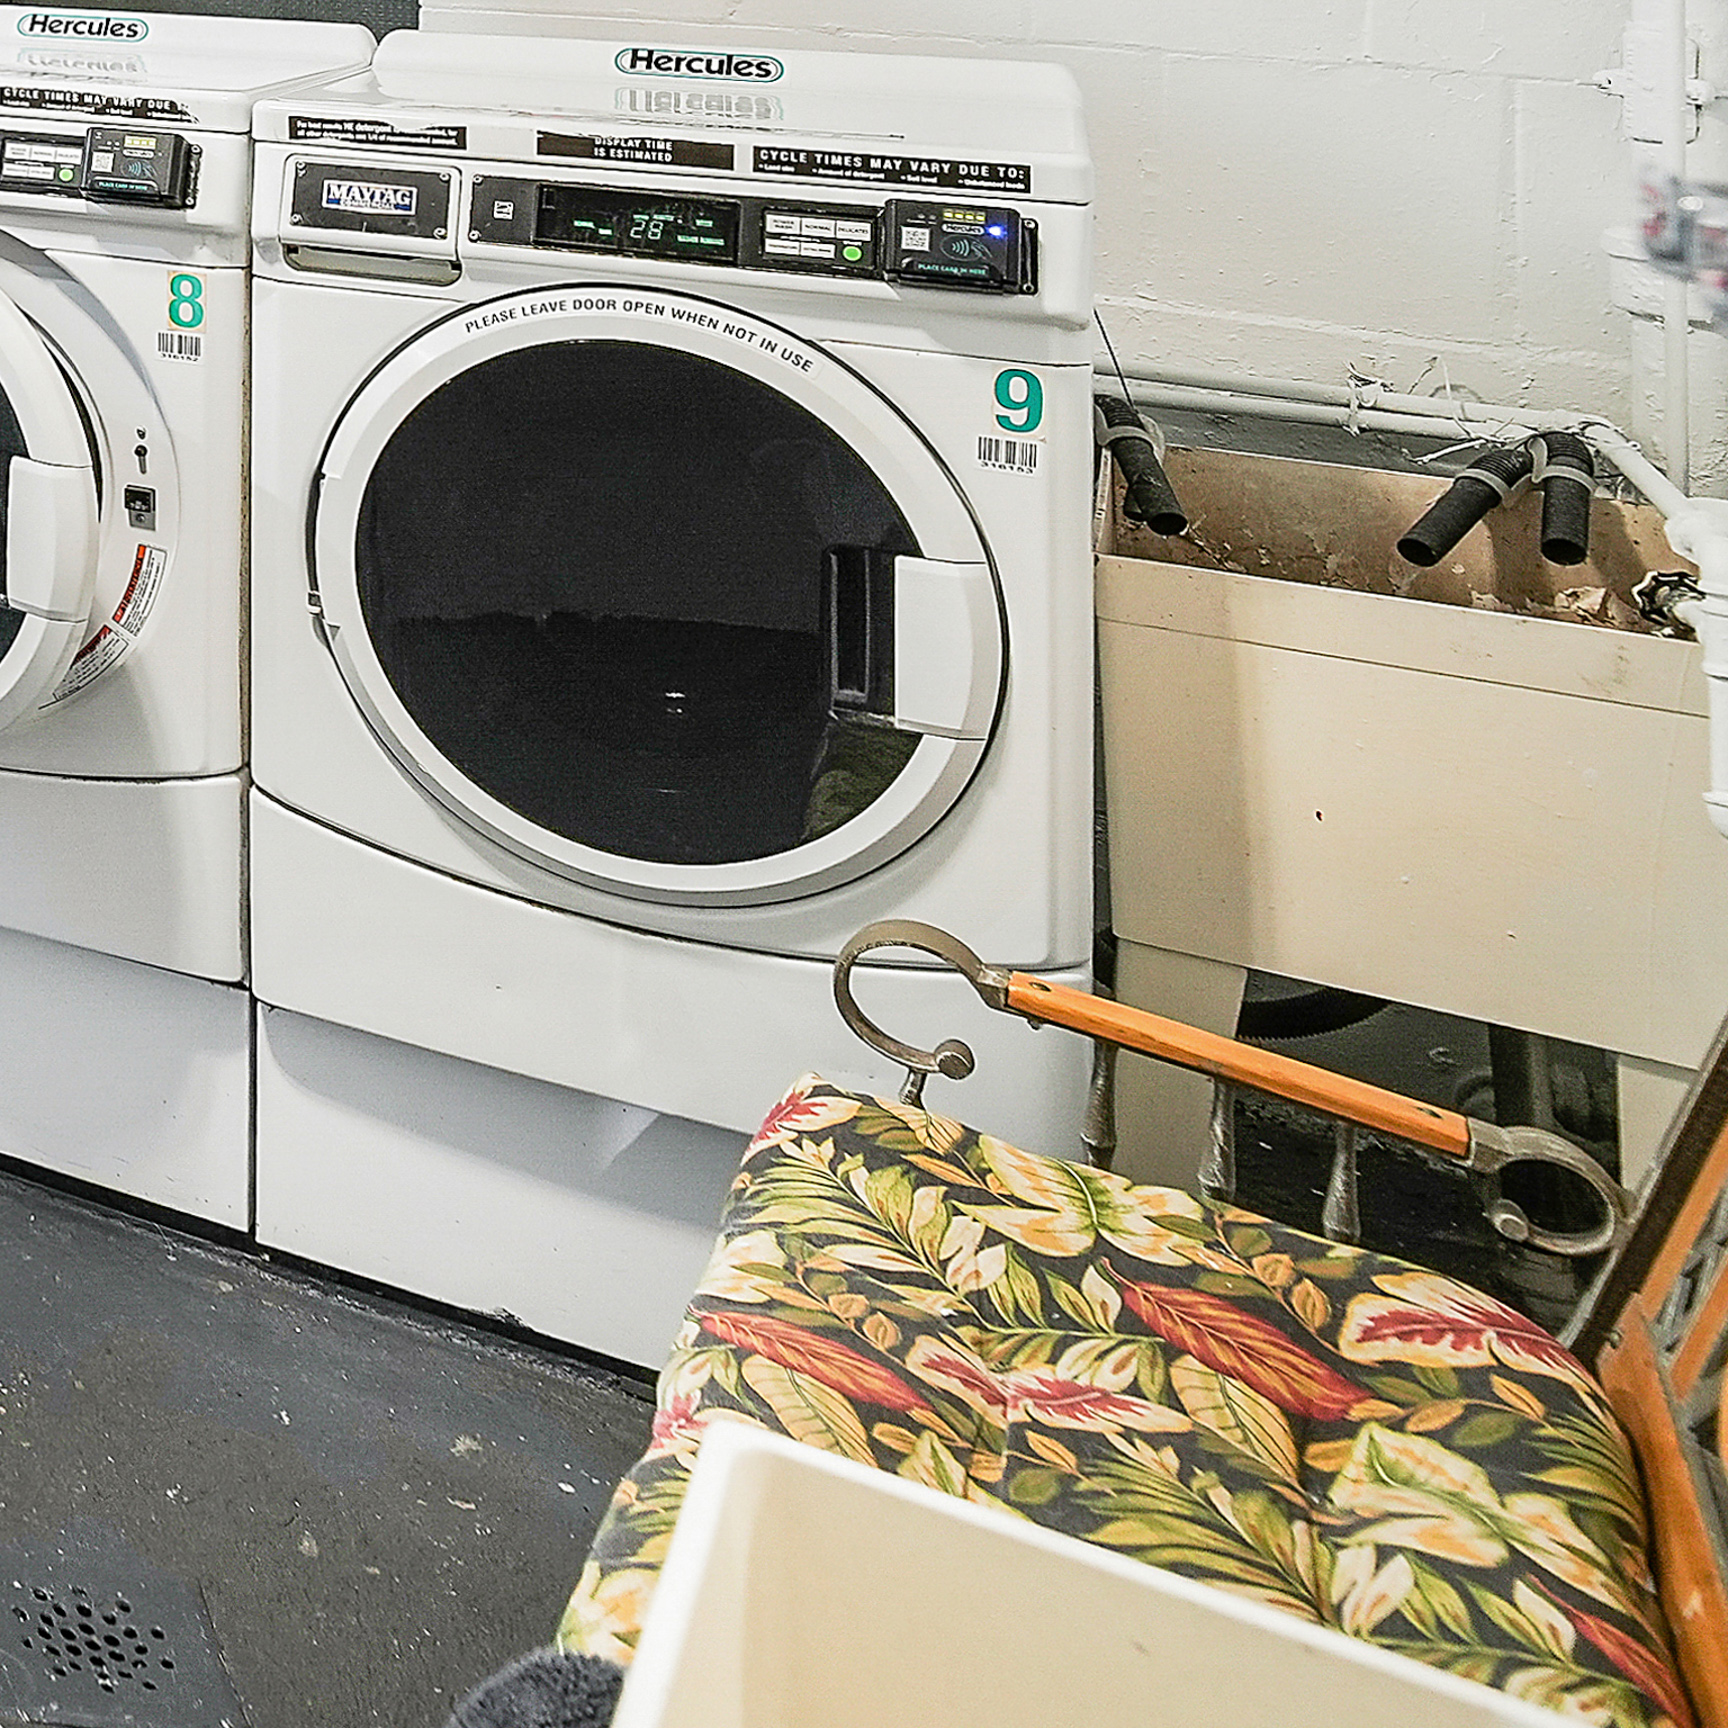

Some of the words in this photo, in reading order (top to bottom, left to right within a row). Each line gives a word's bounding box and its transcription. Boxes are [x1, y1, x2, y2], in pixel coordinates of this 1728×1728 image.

[28, 14, 139, 38] Hercules
[629, 48, 772, 78] Hercules
[3, 88, 39, 100] CYCLE
[45, 90, 79, 103] TIMES
[84, 94, 107, 105] MAY
[113, 96, 143, 109] VARY
[148, 99, 170, 110] DUE
[594, 136, 640, 149] DISPLAY
[645, 139, 673, 151] TIME
[594, 147, 606, 157] IS
[610, 149, 673, 163] ESTIMATED
[759, 149, 808, 164] CYCLE
[815, 153, 863, 169] TIMES
[870, 157, 902, 171] MAY
[910, 161, 952, 174] VARY
[959, 164, 990, 178] DUE
[998, 167, 1025, 180] TO:
[328, 183, 411, 206] MAYTAG
[630, 220, 664, 240] 28
[168, 273, 204, 328] 8
[465, 307, 518, 334] PLEASE
[521, 299, 568, 317] LEAVE
[573, 298, 617, 311] DOOR
[622, 300, 665, 317] OPEN
[671, 308, 720, 331] WHEN
[723, 323, 758, 344] NOT
[760, 336, 778, 354] IN
[780, 347, 815, 374] USE
[994, 368, 1043, 433] 9
